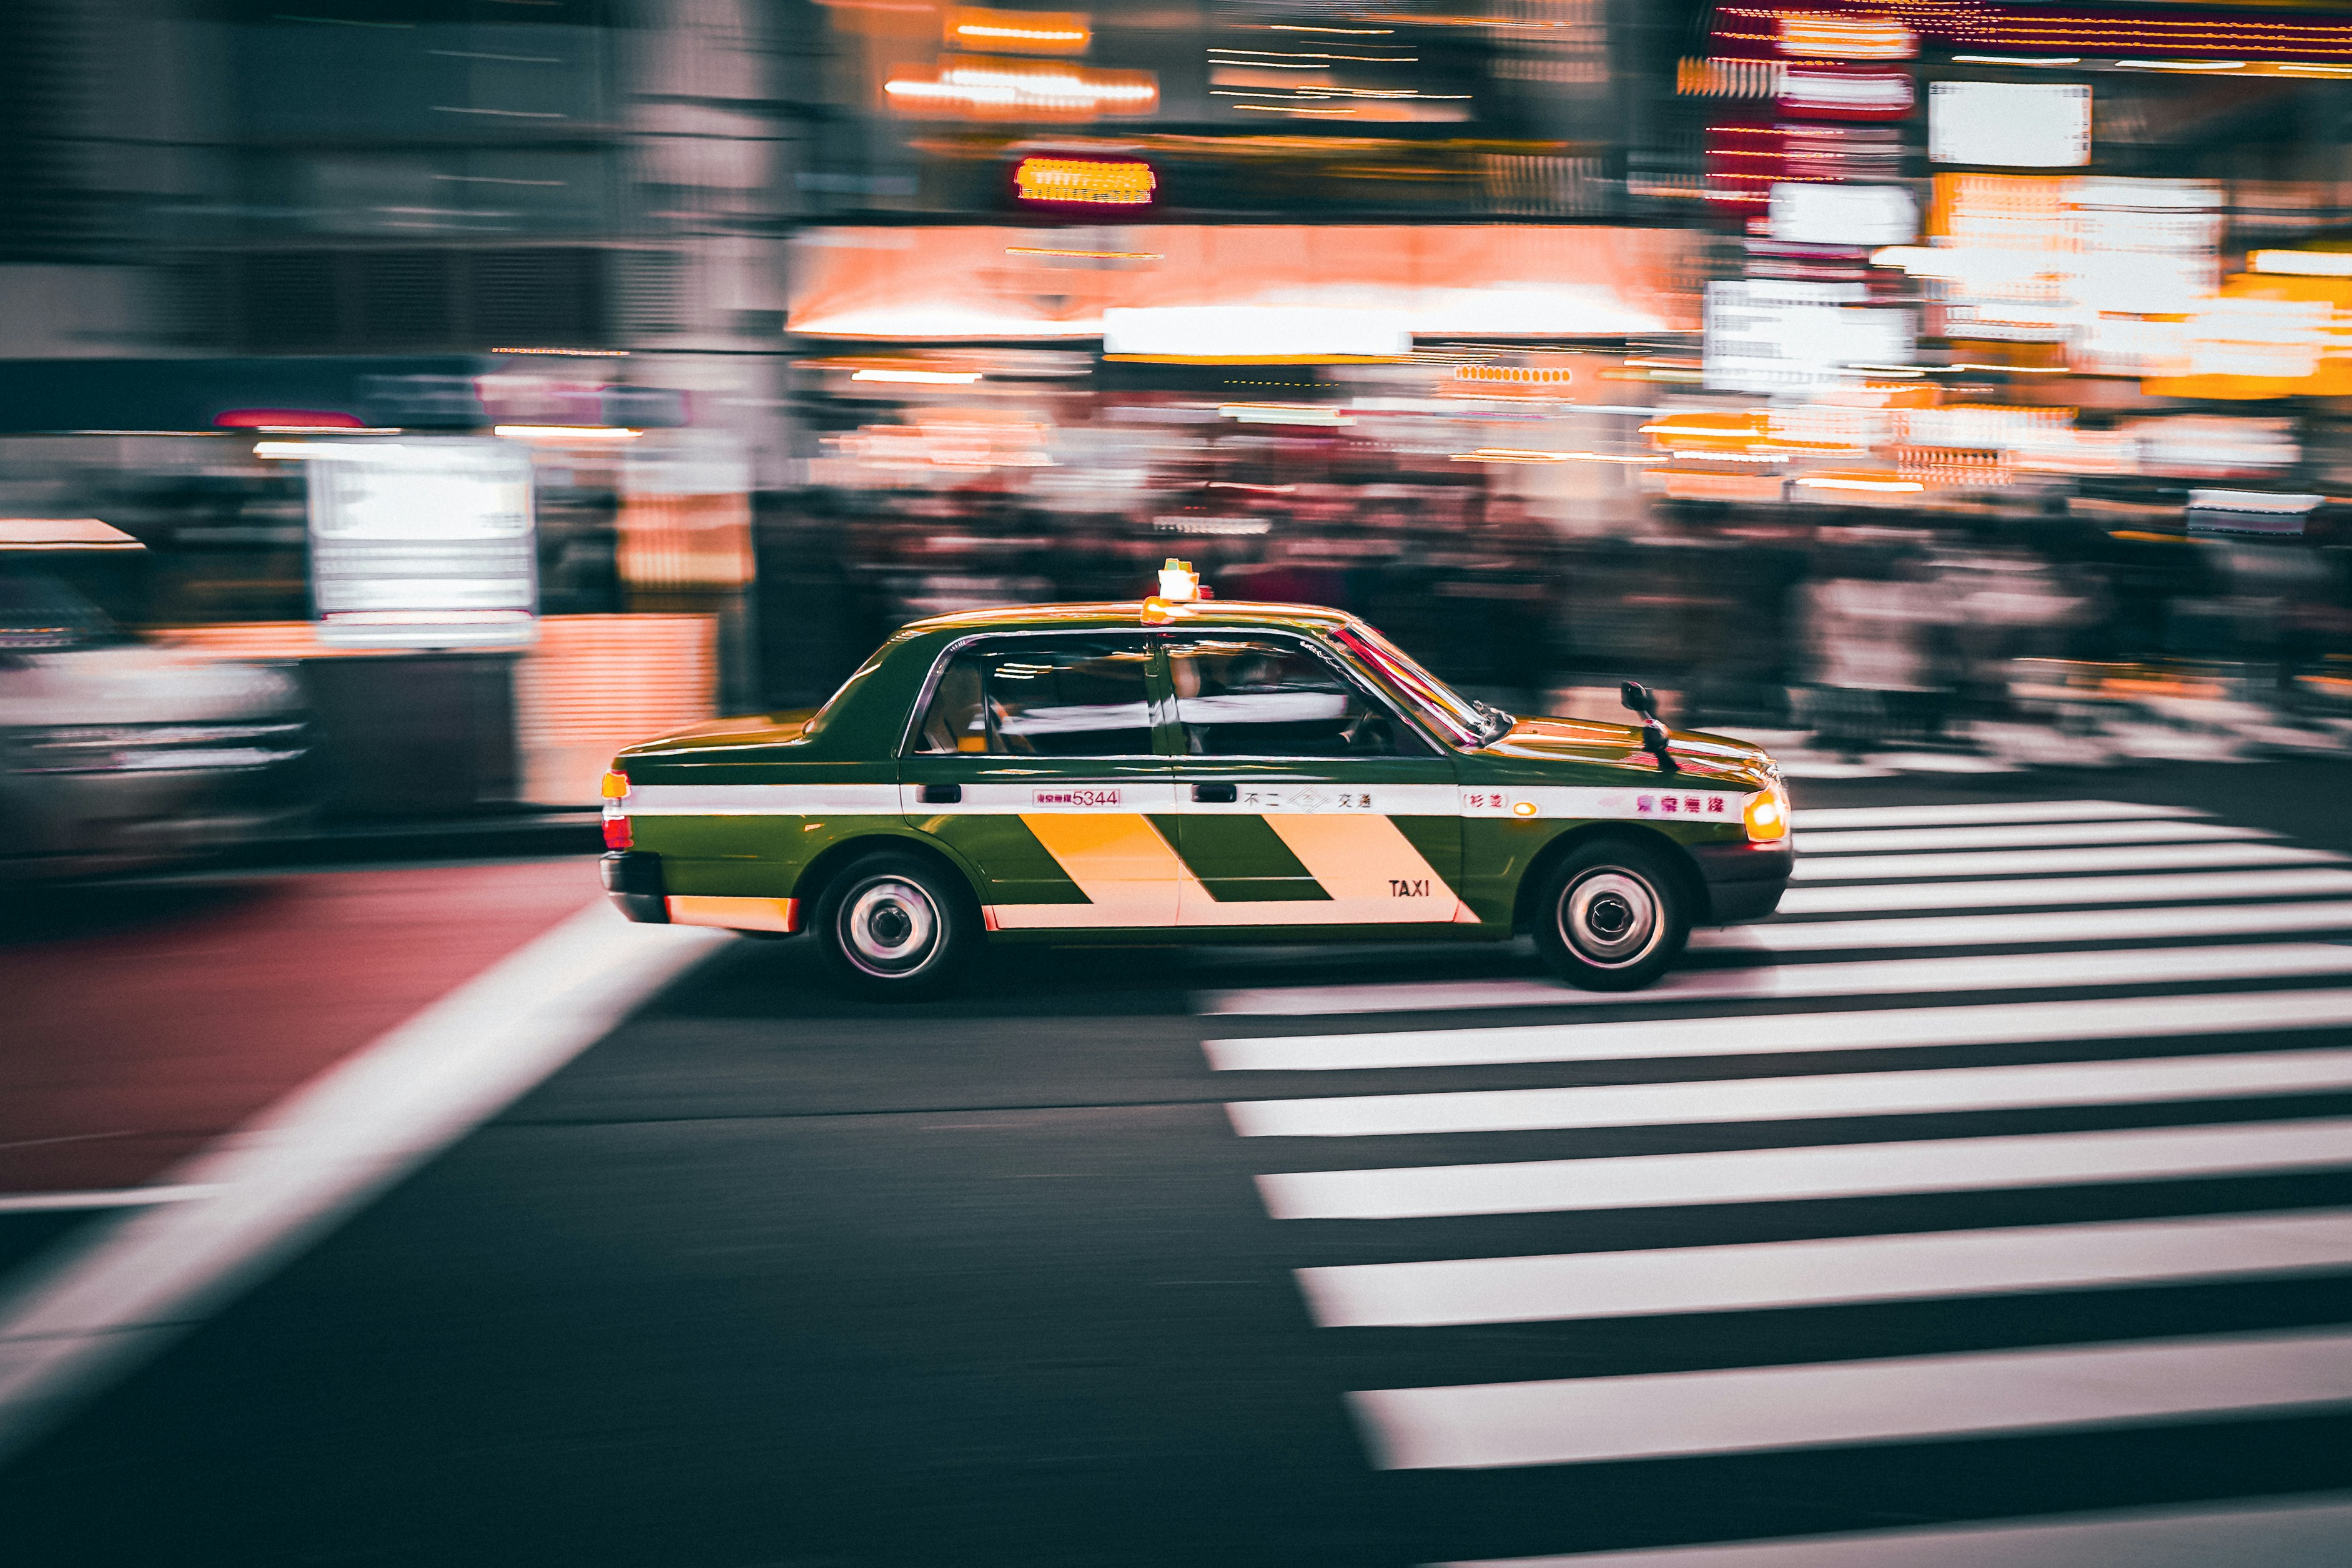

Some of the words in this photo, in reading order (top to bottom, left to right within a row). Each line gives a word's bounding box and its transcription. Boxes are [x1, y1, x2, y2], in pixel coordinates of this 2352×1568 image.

[1072, 791, 1117, 806] 5344
[1338, 793, 1371, 808] 交通
[1388, 880, 1429, 897] TAXI
